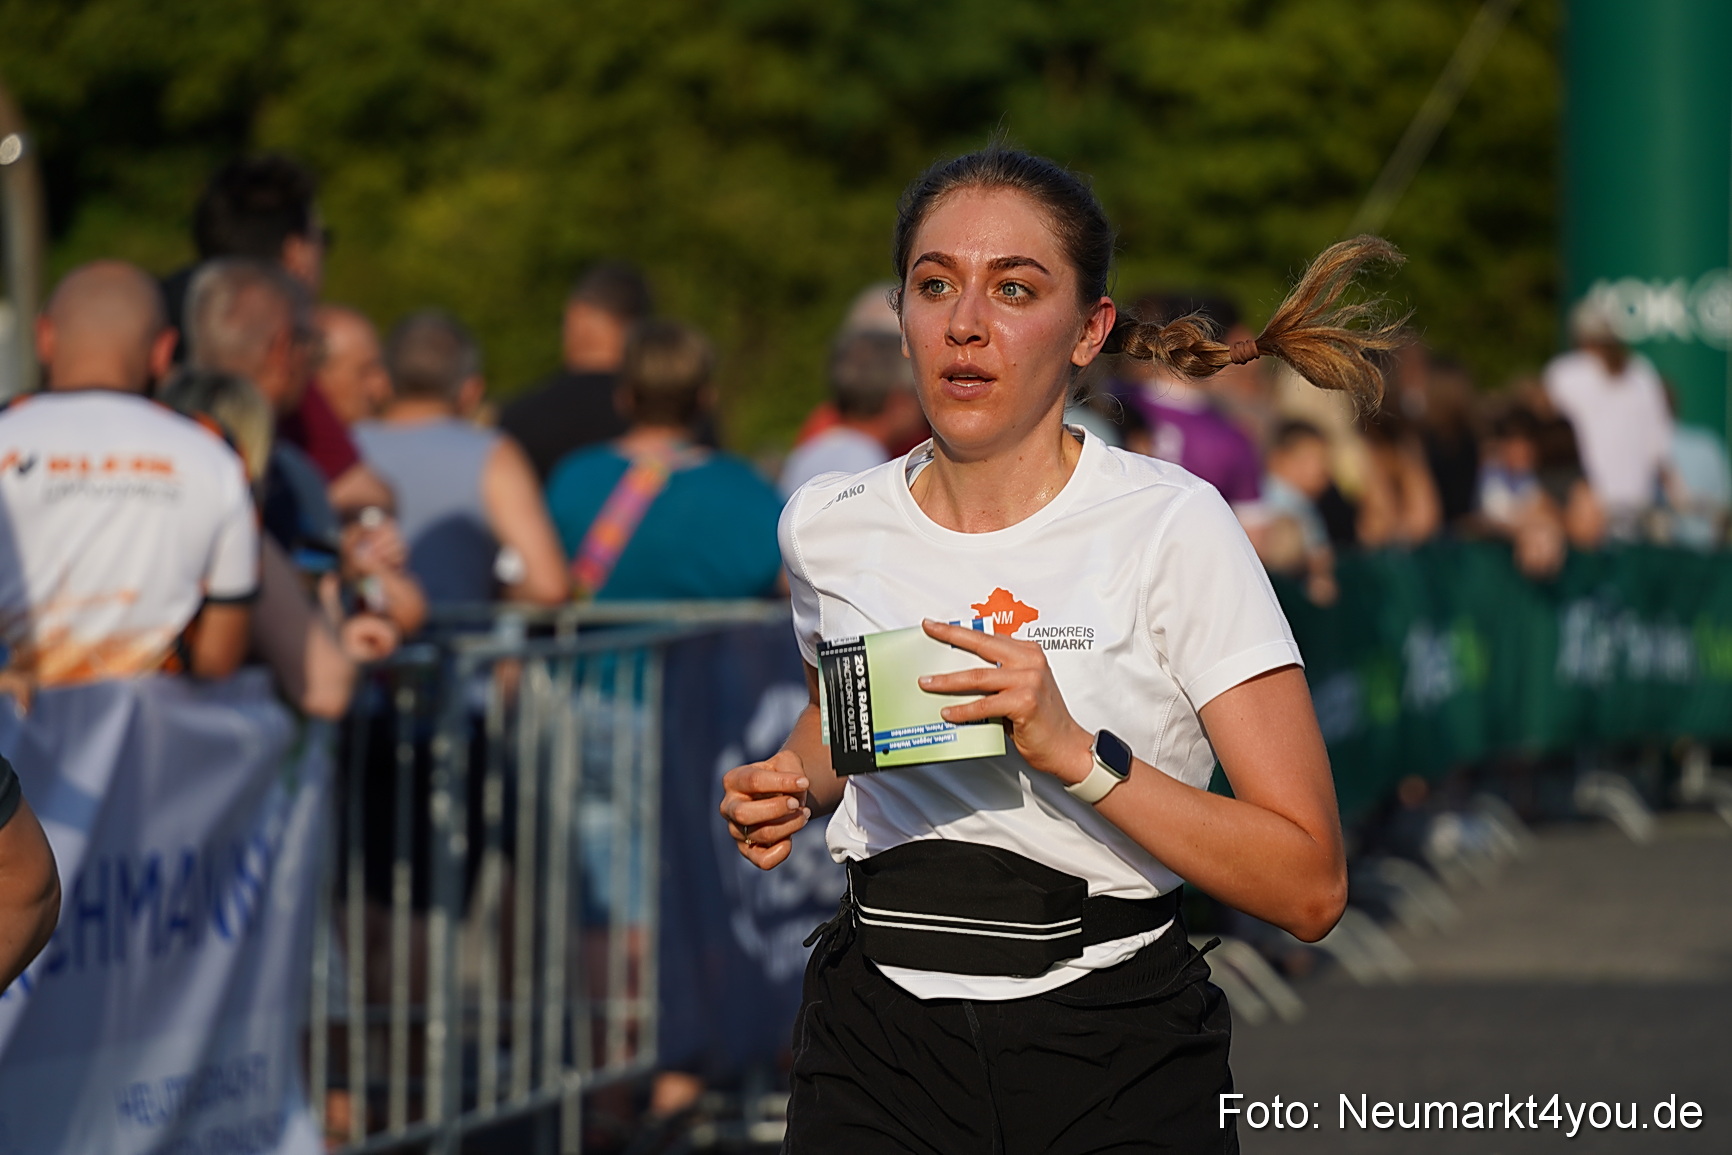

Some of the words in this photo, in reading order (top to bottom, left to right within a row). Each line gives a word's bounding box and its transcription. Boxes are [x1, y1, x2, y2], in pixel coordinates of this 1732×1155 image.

[835, 484, 865, 502] JAKO
[991, 610, 1014, 625] NM
[1027, 626, 1095, 639] LANDKREIS
[1027, 638, 1094, 651] EUMARKT
[853, 654, 865, 676] 20
[842, 656, 855, 706] FACTORY
[847, 706, 858, 753] OUTLET
[857, 691, 871, 752] RABATT
